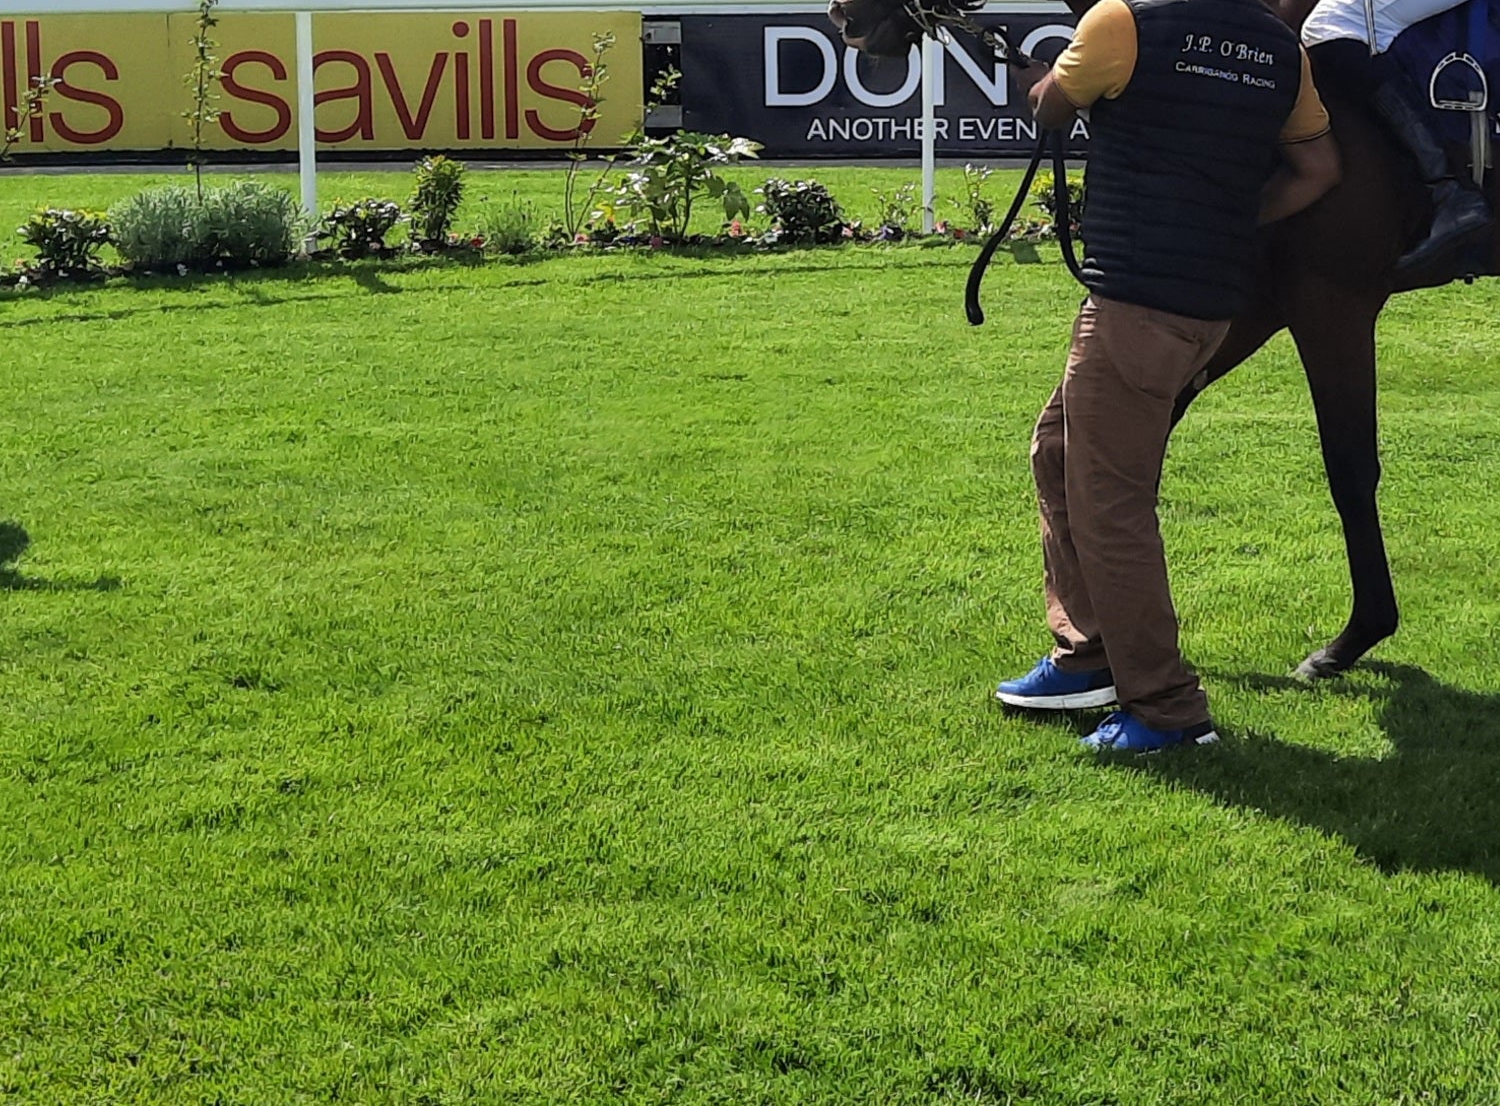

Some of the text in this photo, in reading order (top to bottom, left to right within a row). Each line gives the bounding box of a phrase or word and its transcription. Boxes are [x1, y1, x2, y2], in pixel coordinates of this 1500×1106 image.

[1182, 34, 1213, 53] J.P.
[218, 18, 598, 144] savills
[807, 117, 949, 141] ANOTHER
[959, 118, 1037, 140] EVEN
